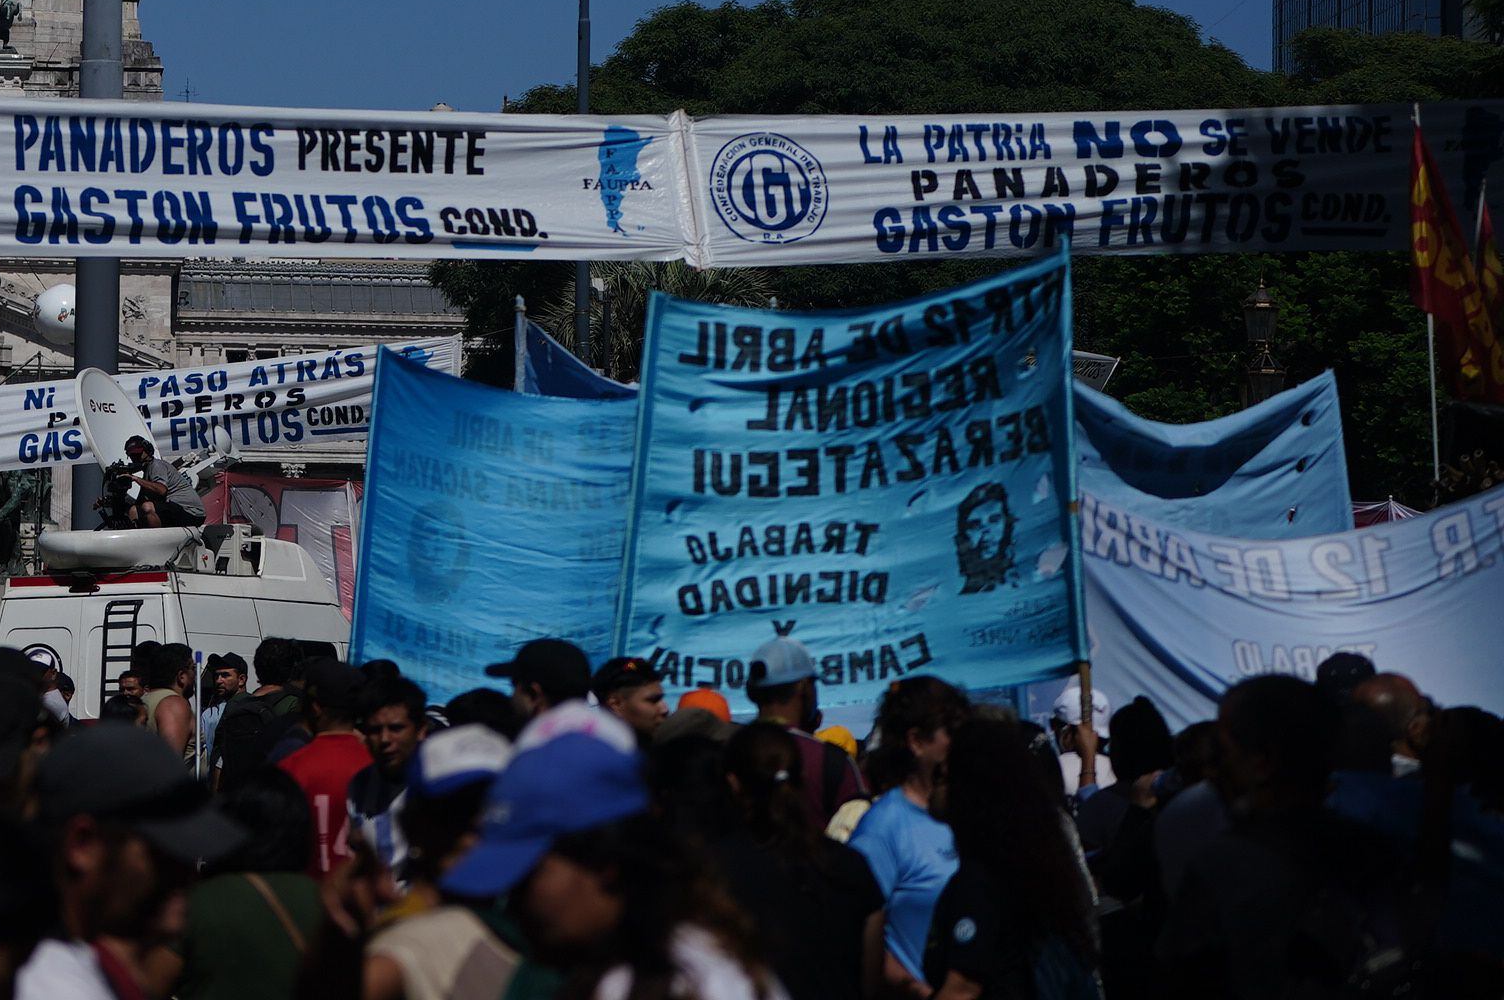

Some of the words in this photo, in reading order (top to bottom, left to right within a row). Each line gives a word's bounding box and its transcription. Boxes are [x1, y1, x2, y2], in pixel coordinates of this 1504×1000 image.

[14, 114, 275, 176] PANADEROS
[297, 127, 486, 175] PRESENTE
[859, 125, 903, 164] LA
[1073, 119, 1183, 158] NO
[1199, 119, 1248, 156] SE
[1265, 116, 1392, 154] VENDE
[582, 178, 654, 191] FAUPPA
[911, 159, 1306, 200] PANADEROS
[13, 185, 218, 244] GASTON
[233, 191, 434, 244] FRUTOS
[439, 207, 548, 239] COND.
[873, 203, 1076, 253] GASTON
[1098, 193, 1293, 248] FRUTOS
[1301, 192, 1392, 224] COND.
[139, 370, 228, 399] PASO
[248, 350, 365, 387] ATRÁS
